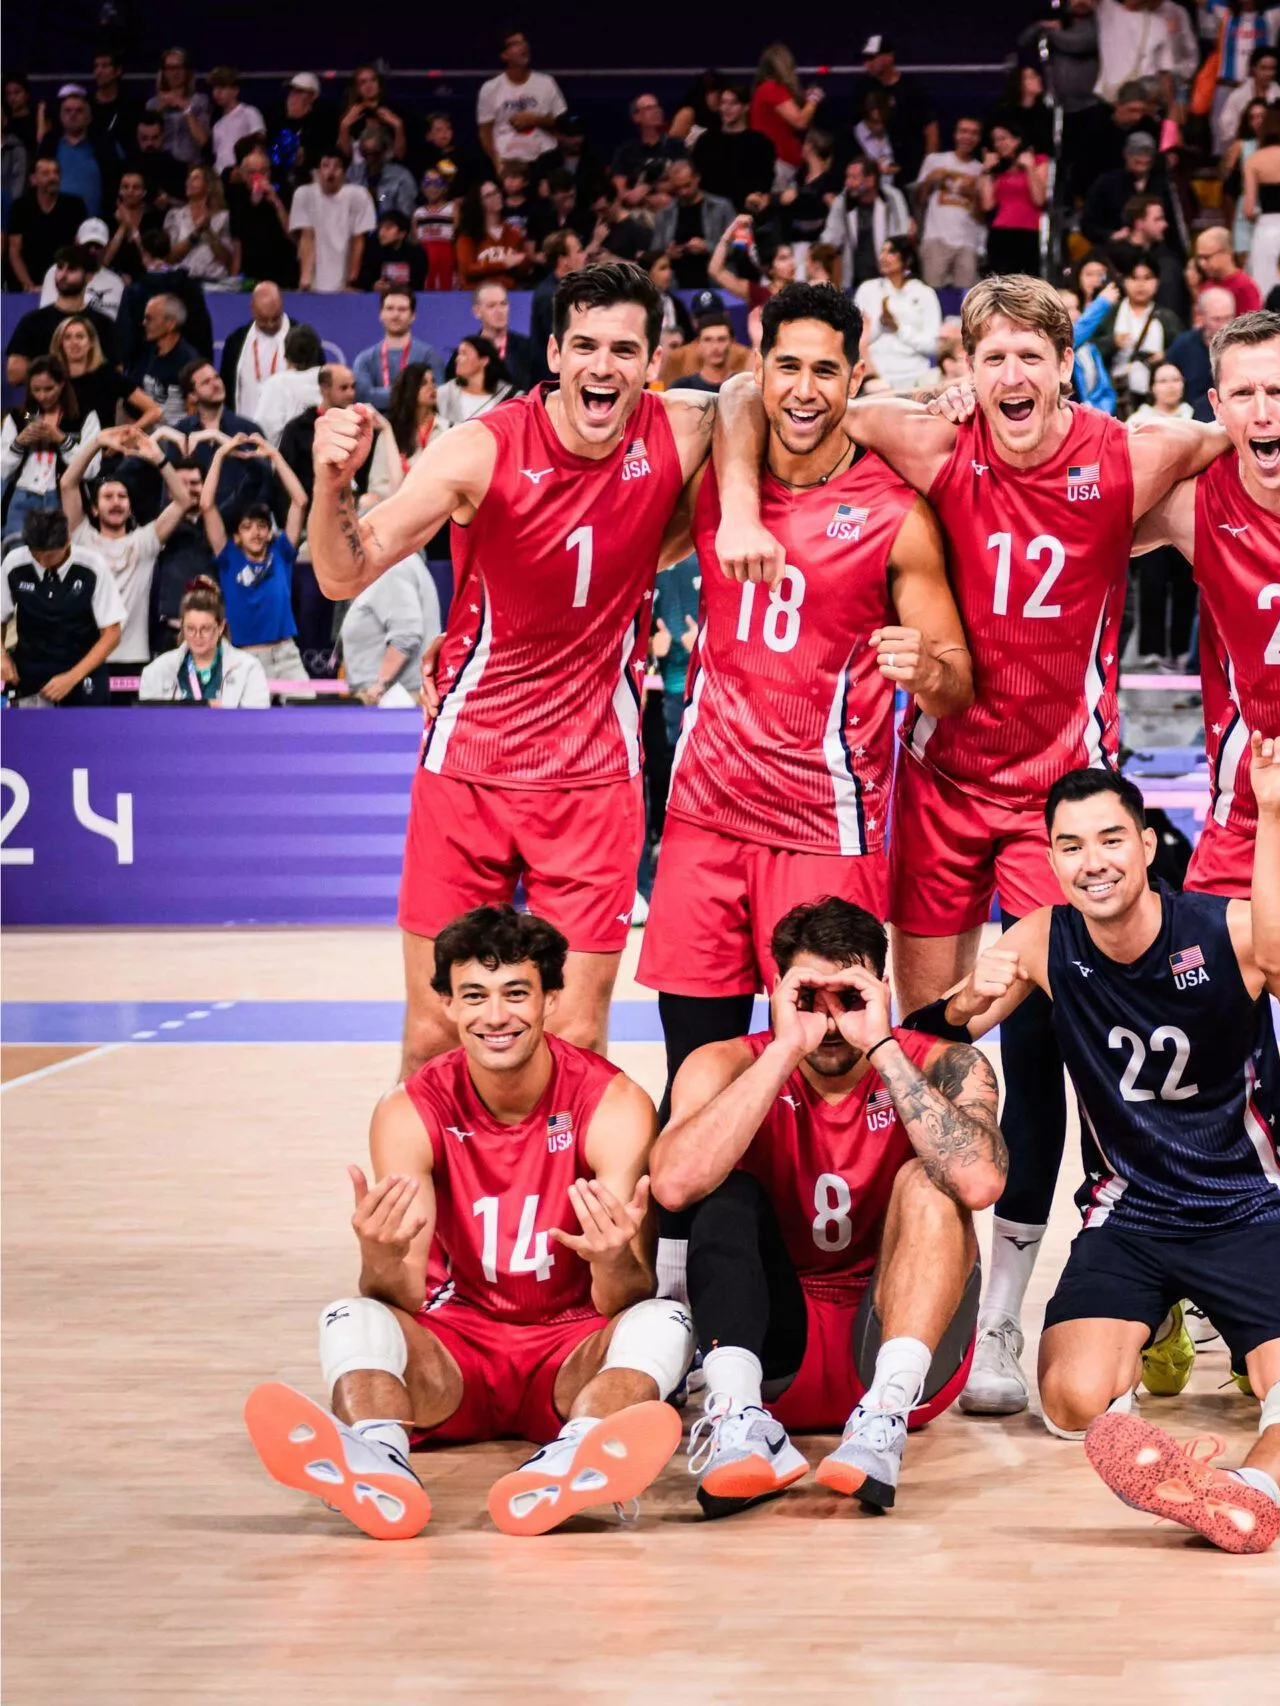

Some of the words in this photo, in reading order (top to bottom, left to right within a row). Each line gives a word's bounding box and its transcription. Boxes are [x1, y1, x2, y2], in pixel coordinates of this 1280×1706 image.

[622, 458, 652, 481] USA
[1067, 484, 1101, 501] USA
[826, 521, 861, 541] USA
[566, 525, 593, 608] 1
[987, 531, 1066, 619] 12
[736, 564, 806, 653] 18
[1174, 966, 1210, 990] USA
[1108, 1025, 1199, 1102] 22
[548, 1131, 573, 1153] USA
[866, 1108, 896, 1131] USA
[812, 1173, 852, 1251] 8
[473, 1194, 555, 1283] 14
